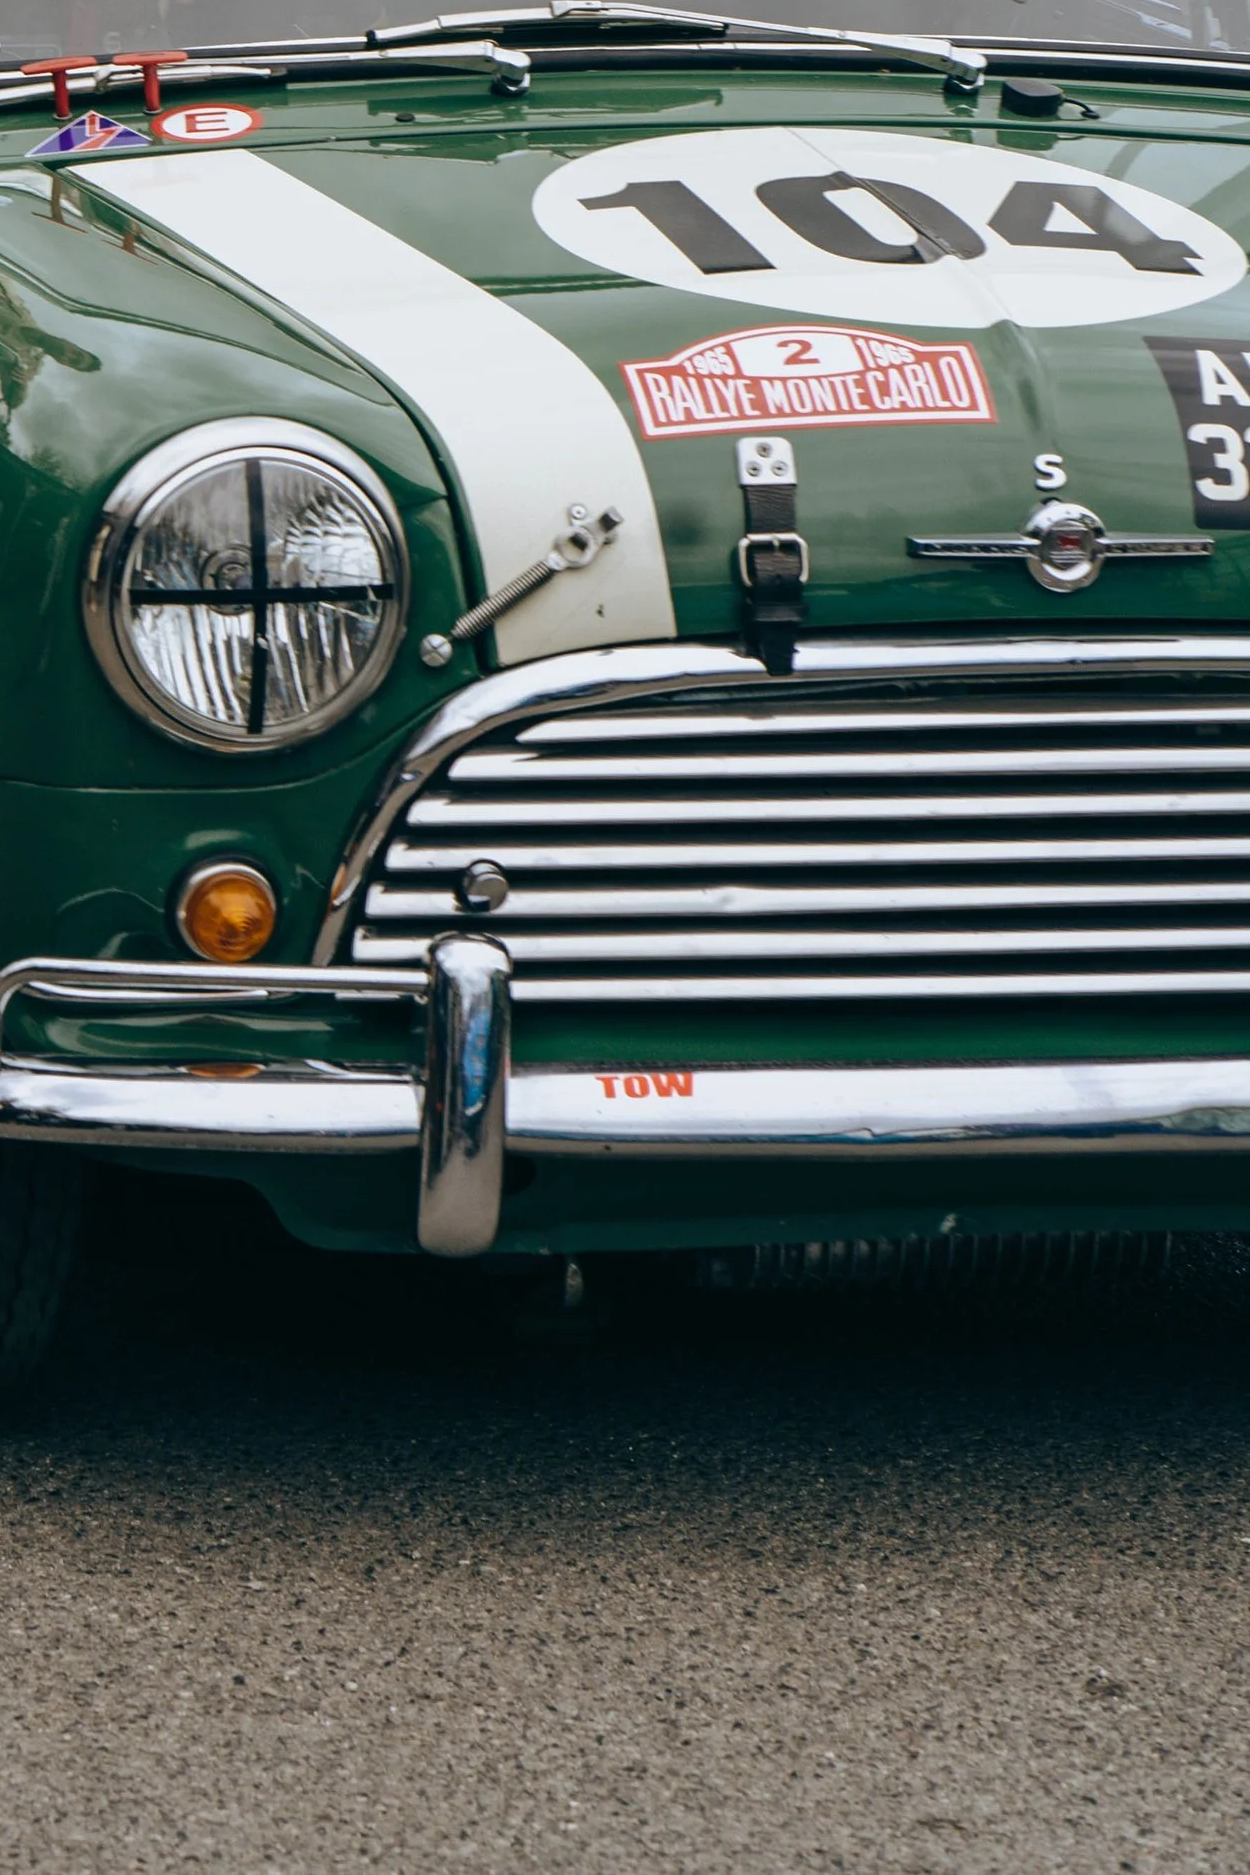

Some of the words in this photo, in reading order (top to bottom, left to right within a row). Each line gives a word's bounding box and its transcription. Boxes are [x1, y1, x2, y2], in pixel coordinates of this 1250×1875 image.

[185, 111, 230, 134] E
[576, 171, 1206, 277] 104
[681, 344, 737, 377] 1965
[775, 338, 821, 366] 2
[854, 336, 917, 369] 1965
[645, 371, 762, 424] RALLYE
[759, 369, 872, 418] MONTE
[865, 356, 971, 413] CARLO
[1195, 348, 1250, 407] A
[1033, 453, 1068, 491] S
[1186, 422, 1250, 502] 3
[594, 1071, 694, 1100] TOW
